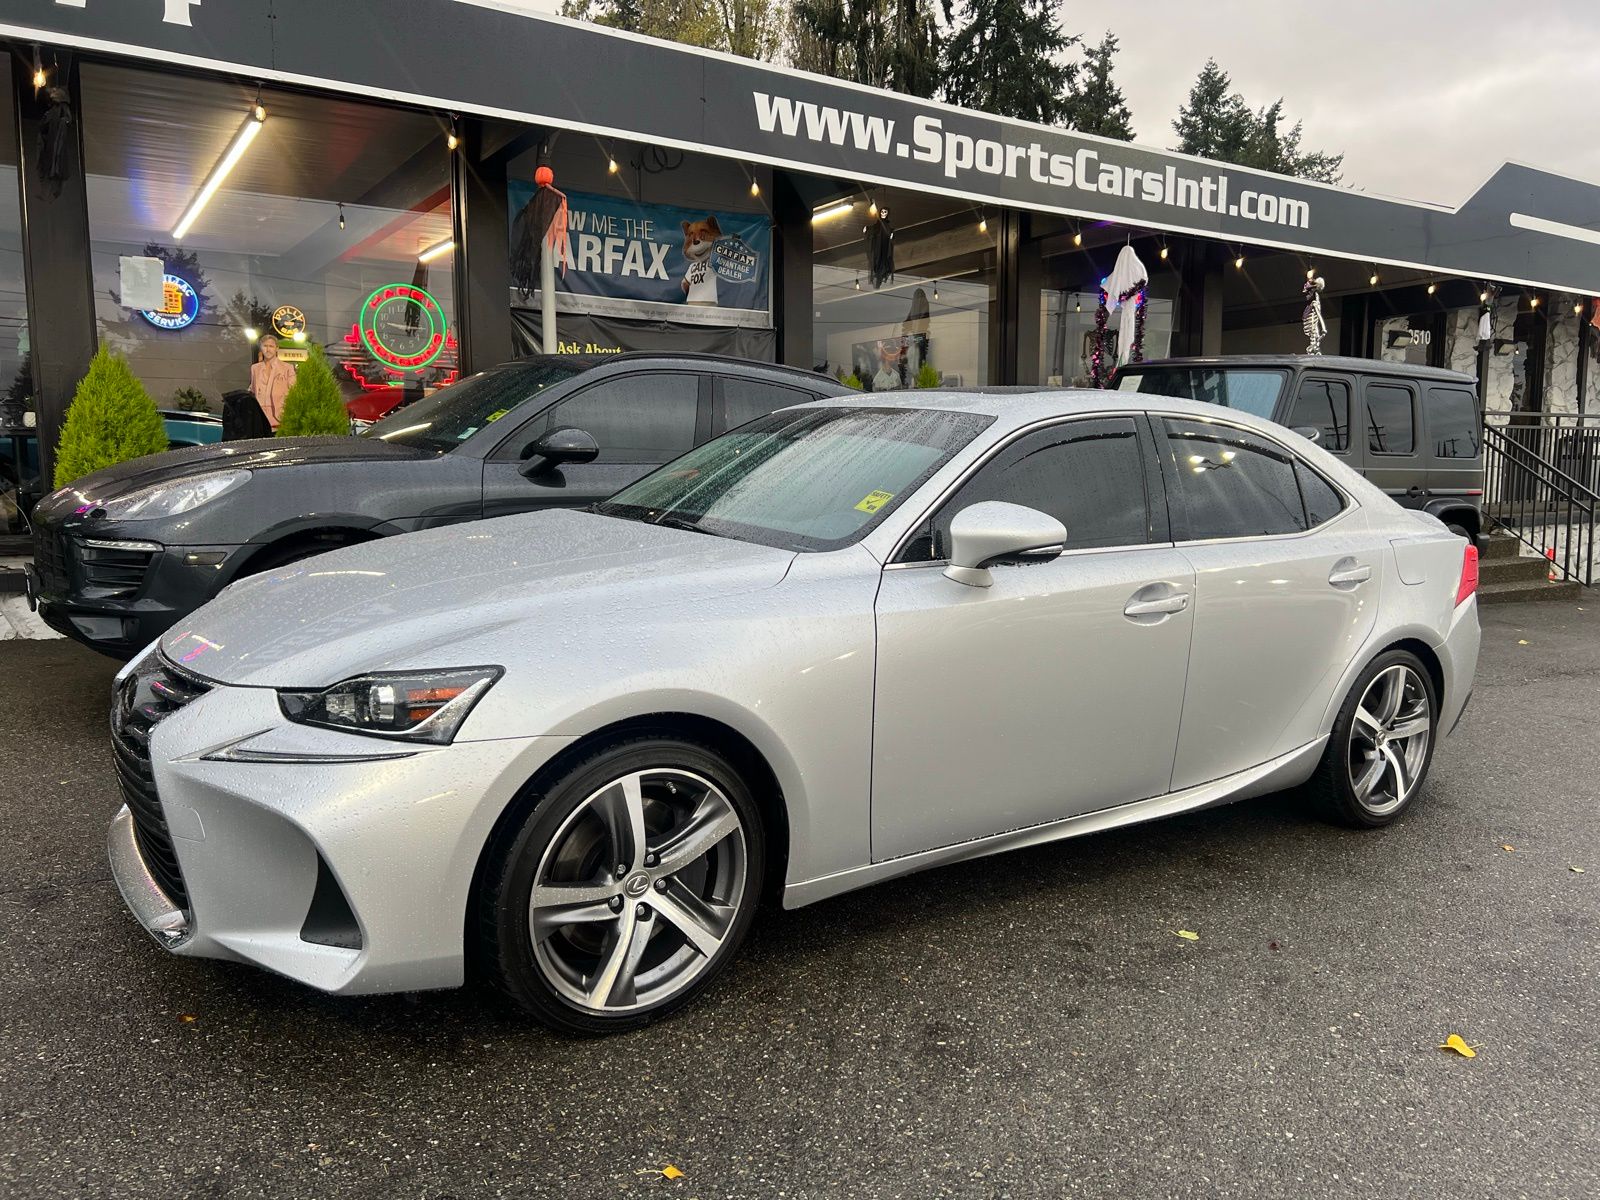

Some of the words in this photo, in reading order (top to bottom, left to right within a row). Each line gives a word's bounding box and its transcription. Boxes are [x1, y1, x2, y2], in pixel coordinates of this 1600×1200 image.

[753, 91, 1310, 229] www.SportsCarsIntl.com
[592, 213, 618, 235] ME
[622, 218, 654, 240] THE
[553, 232, 670, 280] ARFAX
[716, 246, 754, 266] CARFAX
[690, 261, 707, 274] CAR
[716, 256, 750, 274] ADVANTAGE
[718, 267, 742, 279] DEALER
[690, 273, 706, 284] FOX
[147, 311, 191, 327] SERVICE
[274, 307, 304, 322] POLLY
[557, 341, 581, 354] Ask
[585, 343, 622, 354] About
